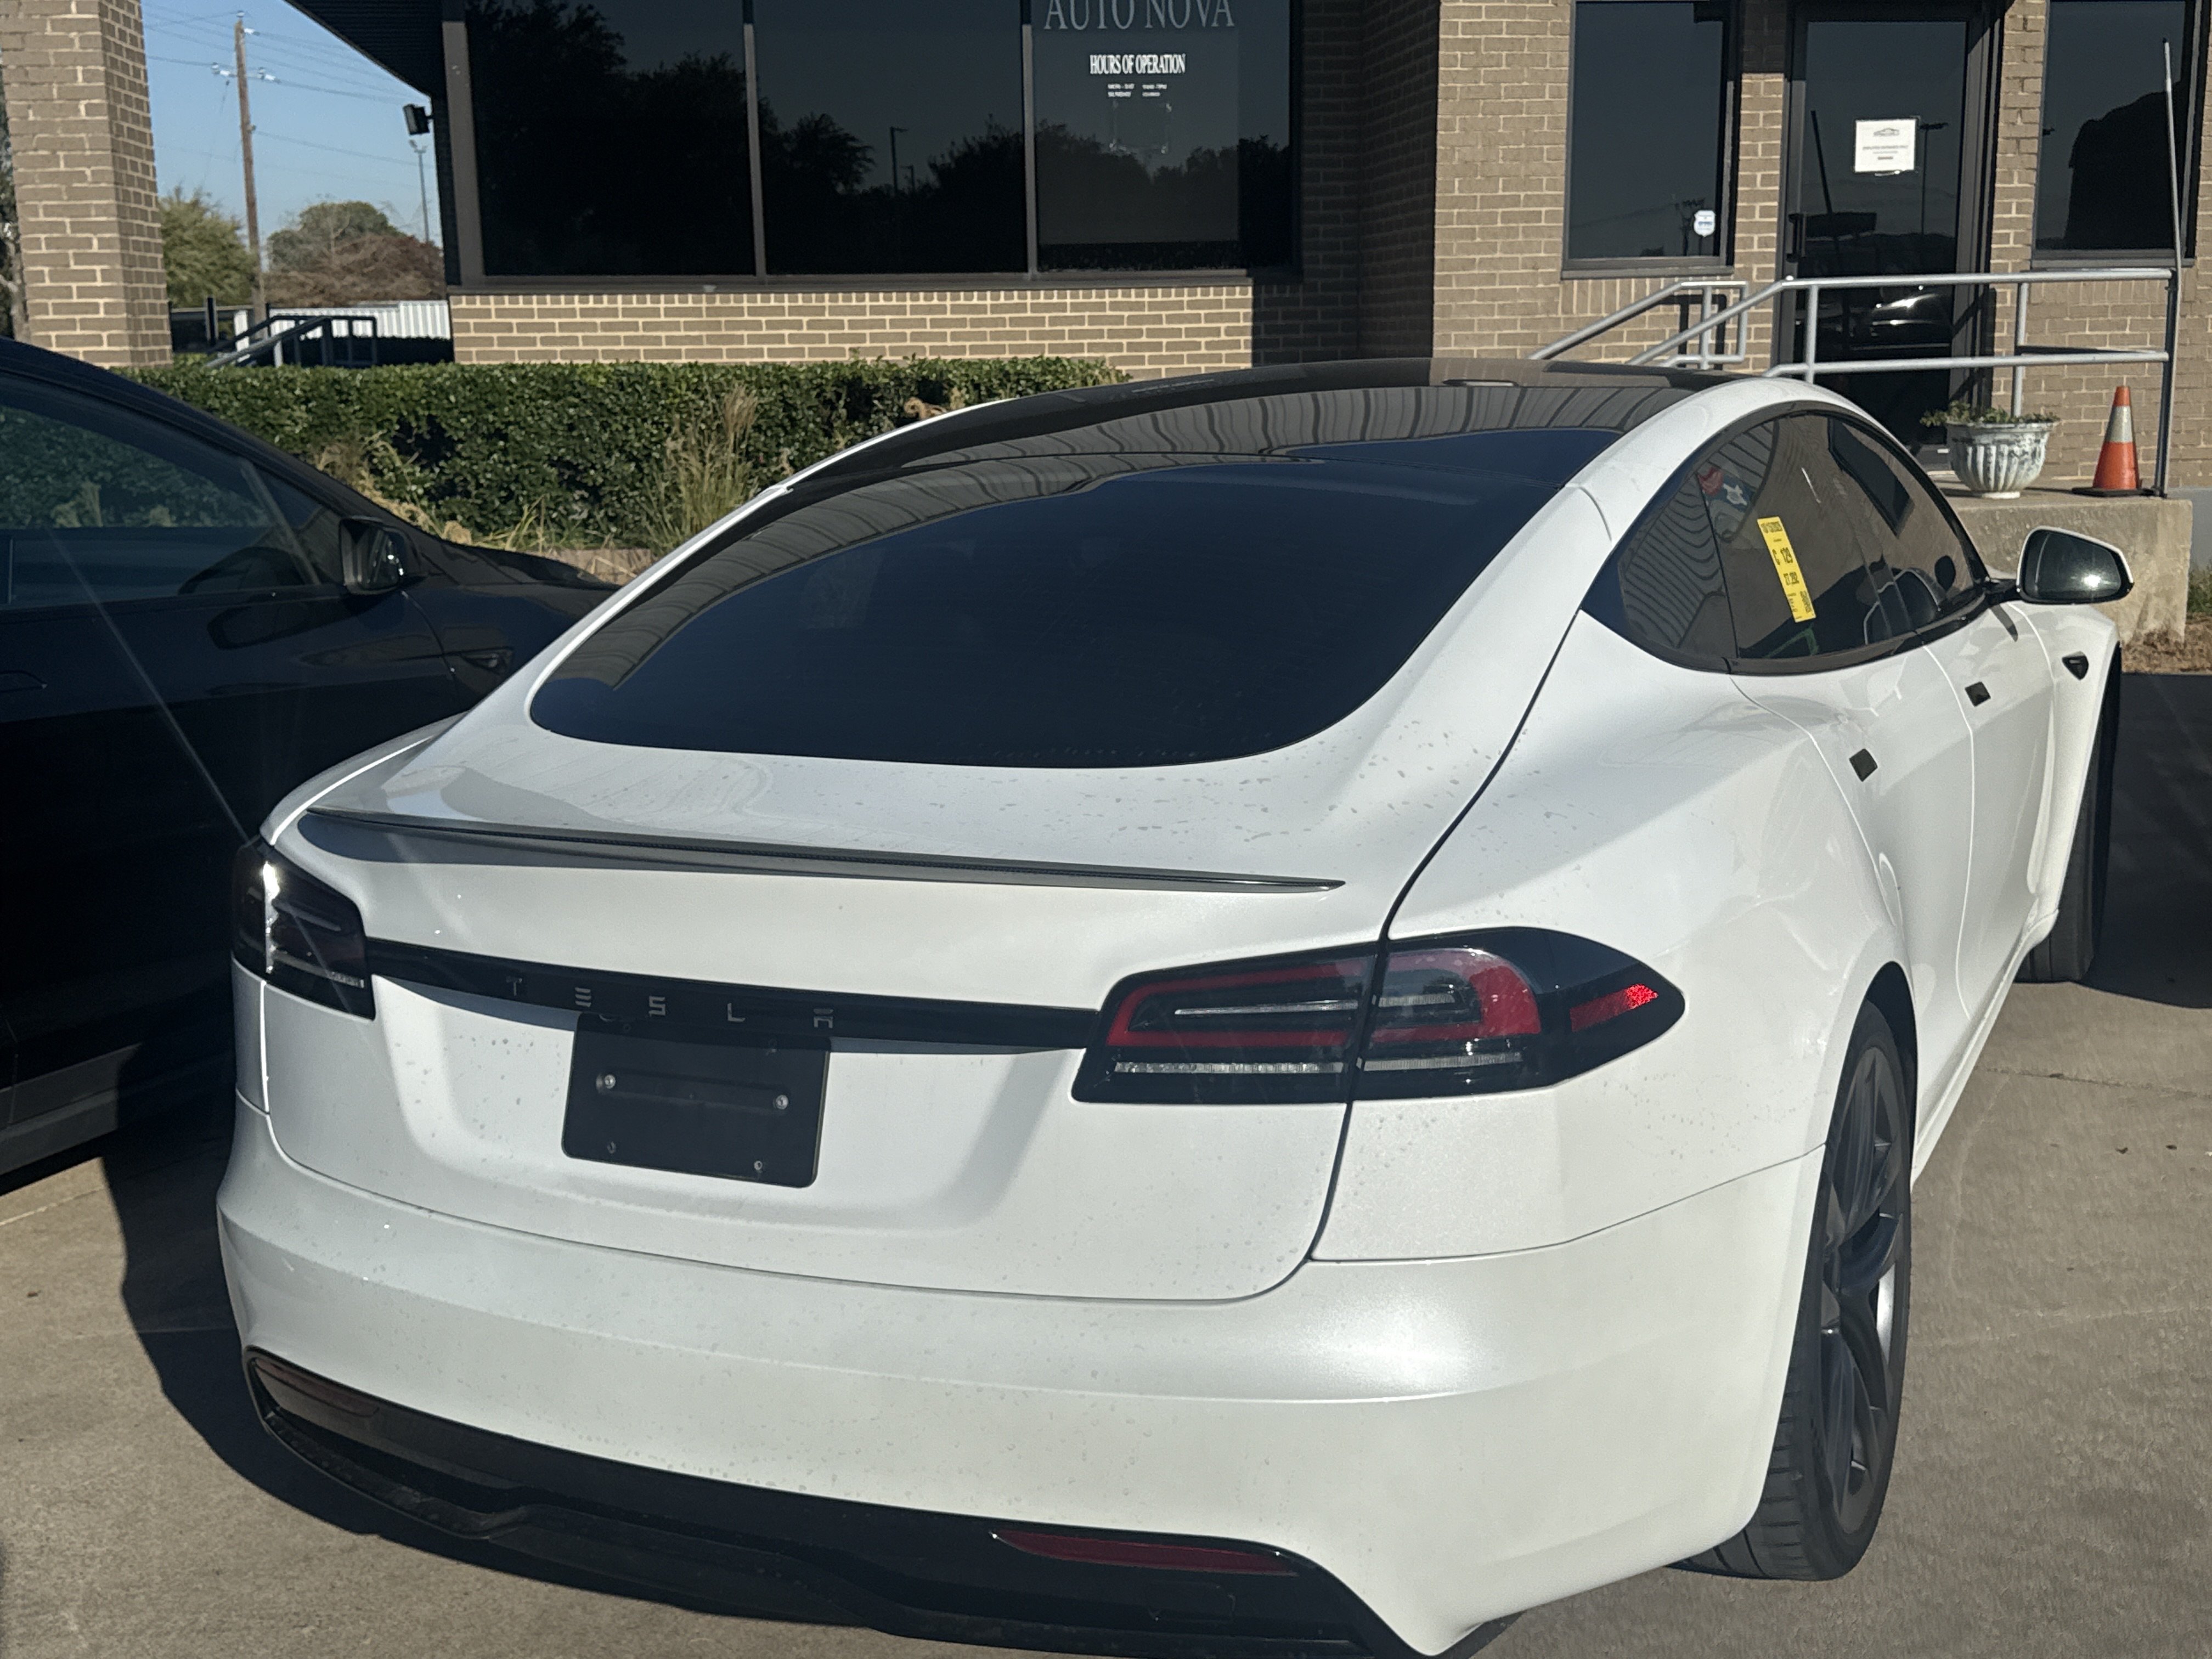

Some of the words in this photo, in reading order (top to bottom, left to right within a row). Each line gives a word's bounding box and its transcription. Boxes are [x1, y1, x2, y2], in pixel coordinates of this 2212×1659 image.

[1044, 0, 1135, 30] AUTO
[1145, 0, 1234, 29] NOVA
[1090, 54, 1121, 75] HOURS
[1121, 54, 1135, 75] OF
[1135, 53, 1186, 75] OPERATION
[506, 976, 834, 1029] TESLA
